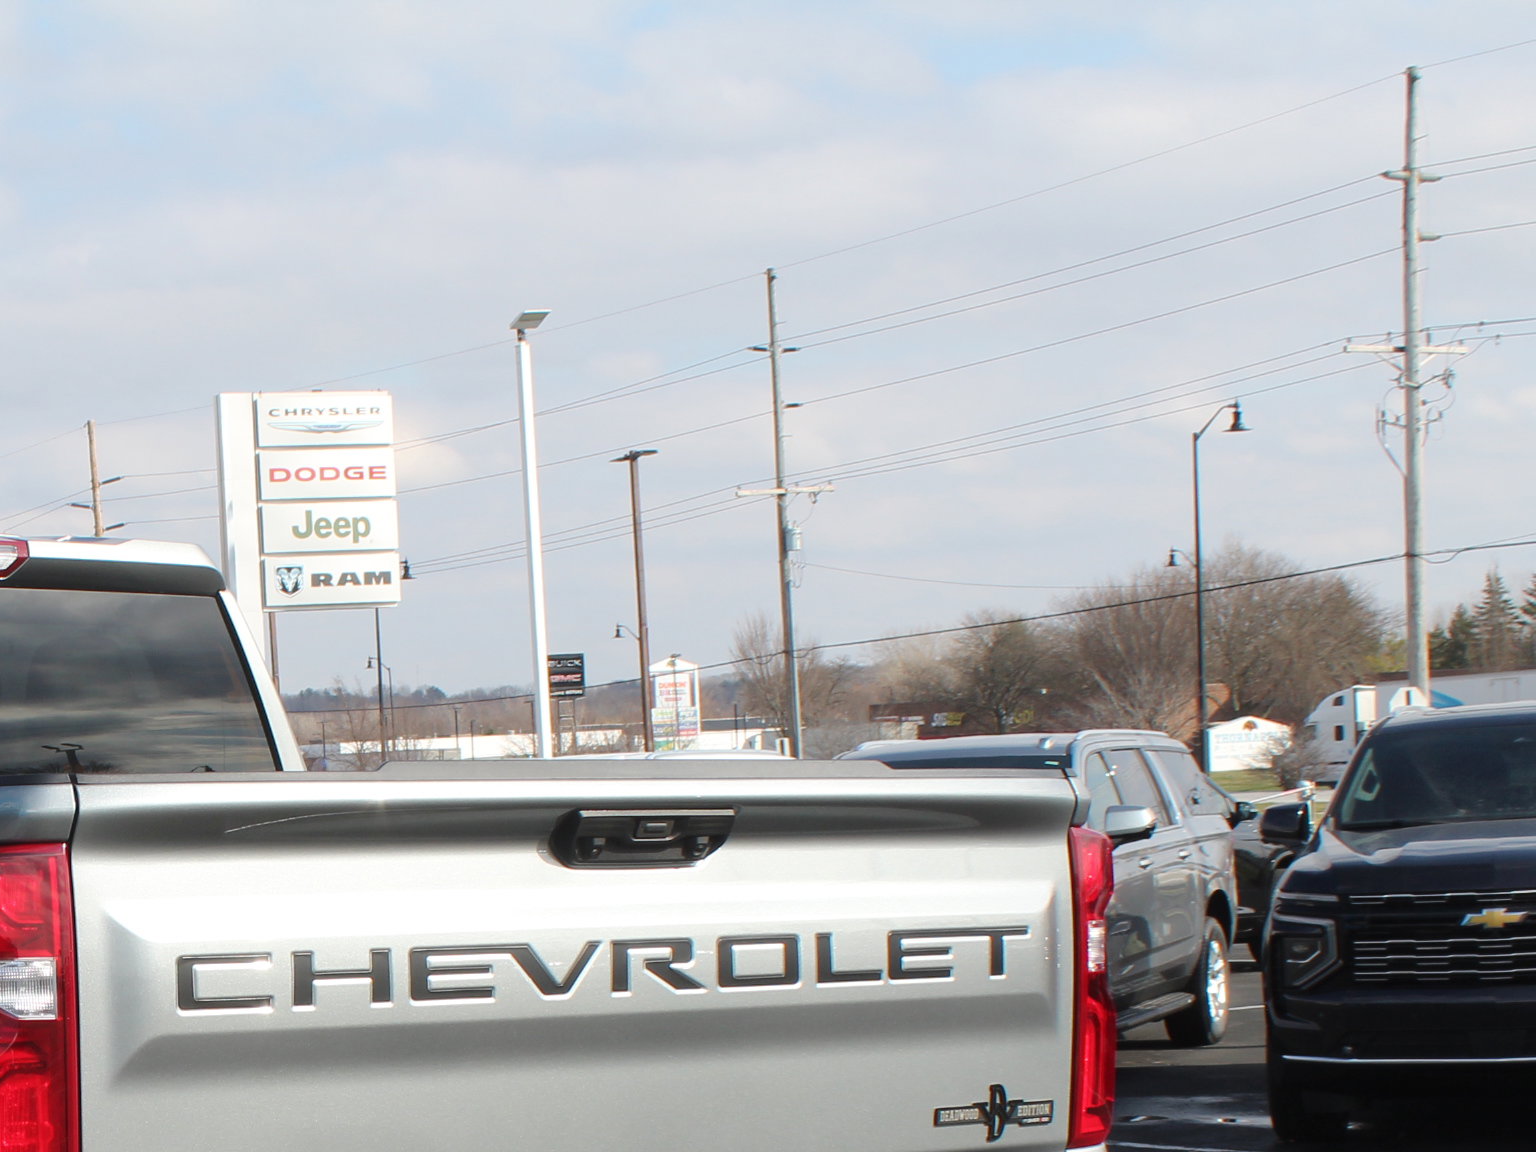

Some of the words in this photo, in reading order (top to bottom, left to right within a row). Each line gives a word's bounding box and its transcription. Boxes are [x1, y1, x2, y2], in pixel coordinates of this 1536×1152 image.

[268, 406, 381, 417] CHRYSLER
[269, 466, 387, 482] DODGE
[292, 510, 371, 543] Jeep
[311, 571, 392, 587] RAM
[176, 926, 1031, 1013] CHEVROLET
[1017, 1103, 1050, 1116] EDITION
